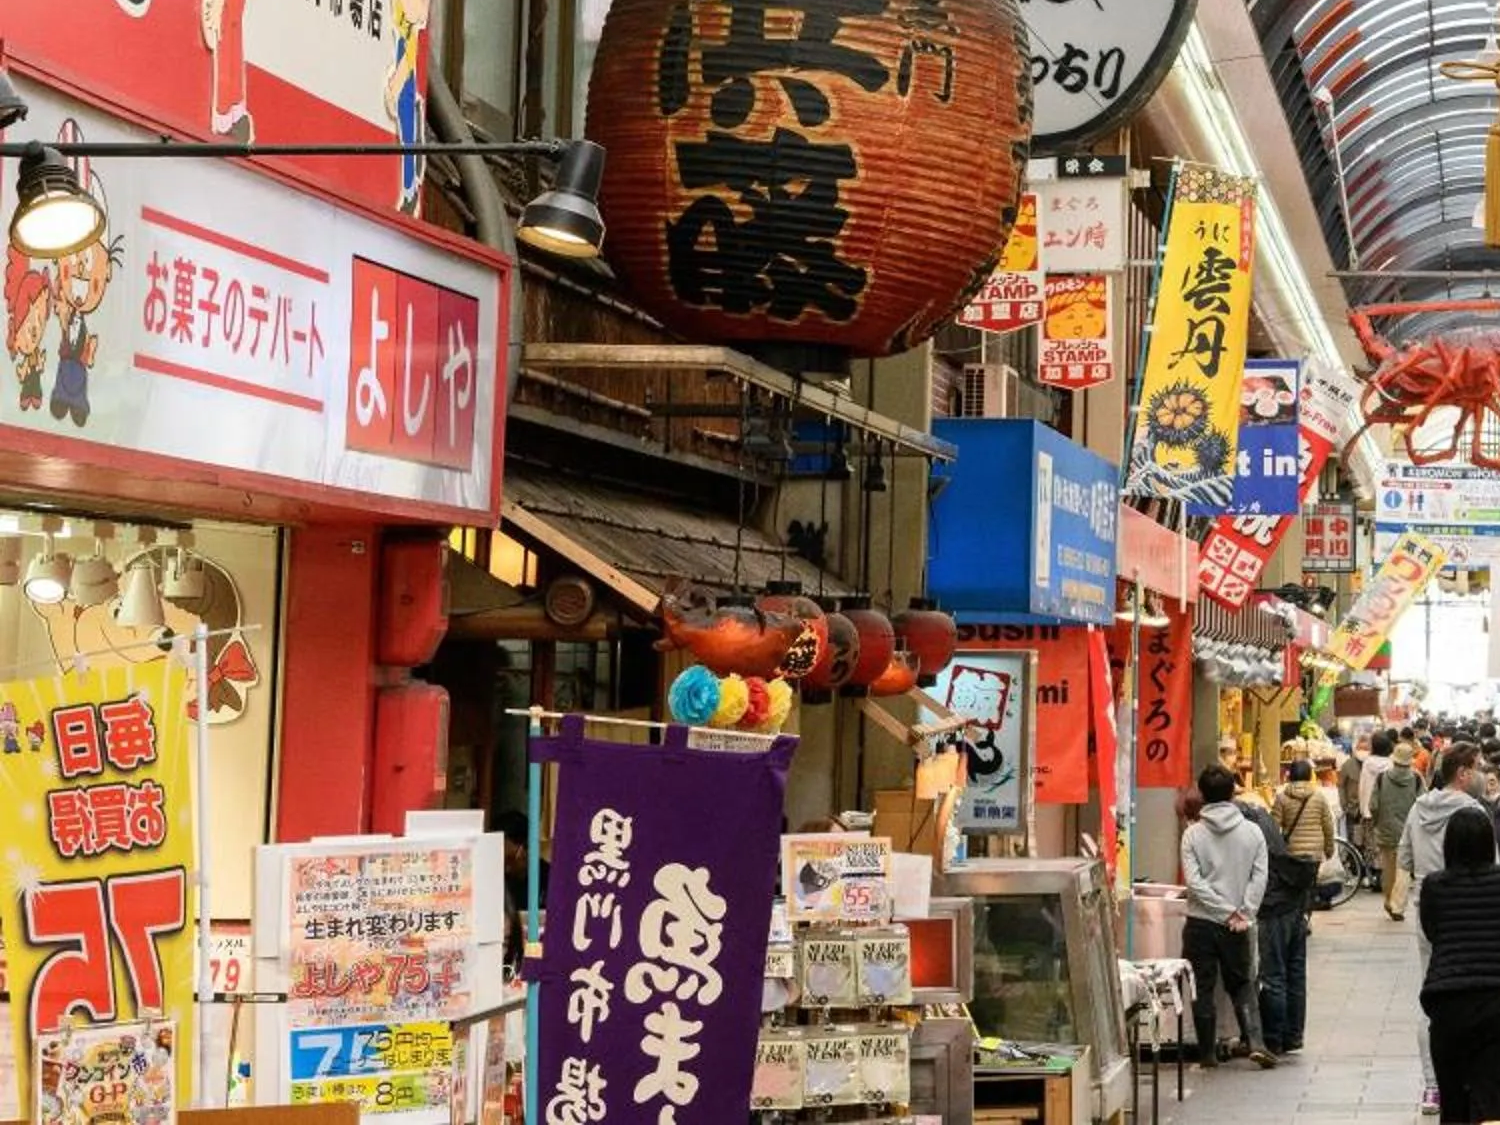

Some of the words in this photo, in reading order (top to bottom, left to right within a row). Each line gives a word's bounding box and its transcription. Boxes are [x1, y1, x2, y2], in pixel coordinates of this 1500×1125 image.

[1194, 220, 1230, 243] うに
[980, 285, 1039, 300] TAMP
[143, 250, 325, 378] お菓子のデパート
[1166, 246, 1237, 379] 雲丹
[354, 286, 474, 448] よしや
[1043, 349, 1108, 364] STAMP
[1044, 363, 1108, 380] 加盟店
[304, 911, 460, 940] 生まれ変わります
